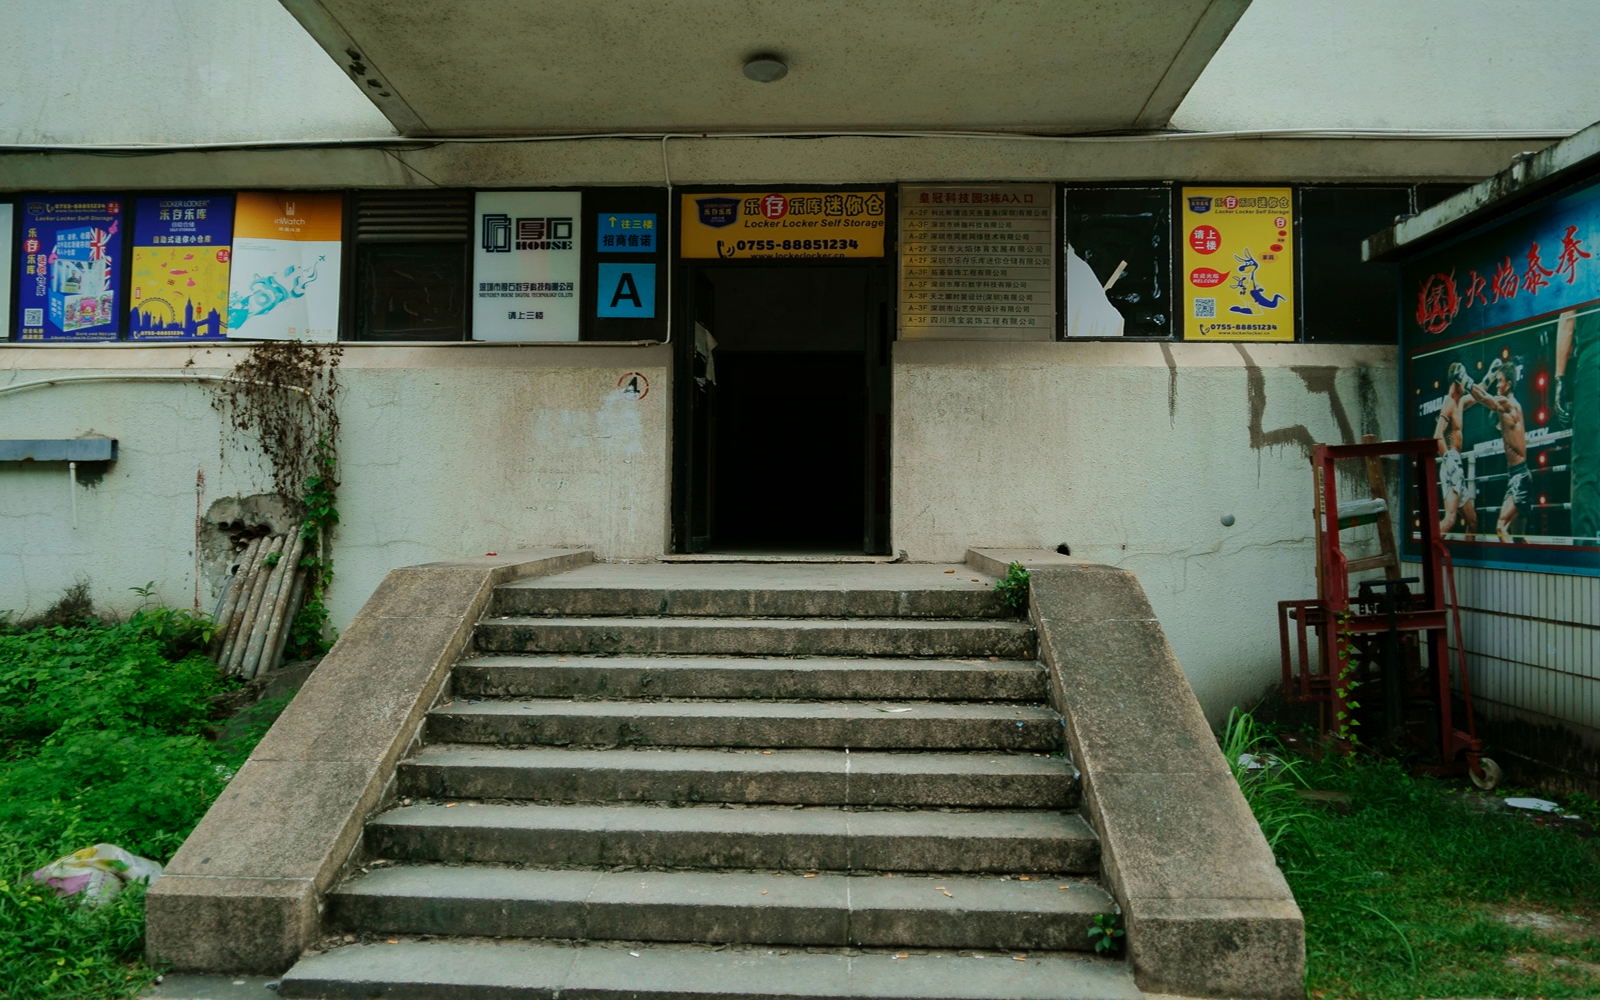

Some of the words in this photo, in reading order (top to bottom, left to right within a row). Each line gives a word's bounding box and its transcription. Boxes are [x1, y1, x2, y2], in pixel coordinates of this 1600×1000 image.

[919, 192, 1034, 204] 皇冠科技园3栋A入口
[743, 194, 885, 217] 乐存乐库迷你仓
[159, 209, 207, 220] 乐存乐库
[274, 217, 306, 226] inWatch
[744, 219, 781, 228] Locker
[782, 219, 819, 228] Locker
[820, 218, 842, 228] Self
[843, 219, 885, 229] Storage
[1194, 229, 1217, 240] 请上
[515, 241, 573, 250] HOUSE
[603, 234, 652, 247] 招商信诺
[736, 239, 859, 251] 0755-88851234
[1194, 240, 1217, 251] 二楼
[1464, 225, 1591, 308] 火焰泰拳
[610, 272, 643, 307] A
[508, 311, 544, 320] 请上三楼
[623, 376, 640, 394] A
